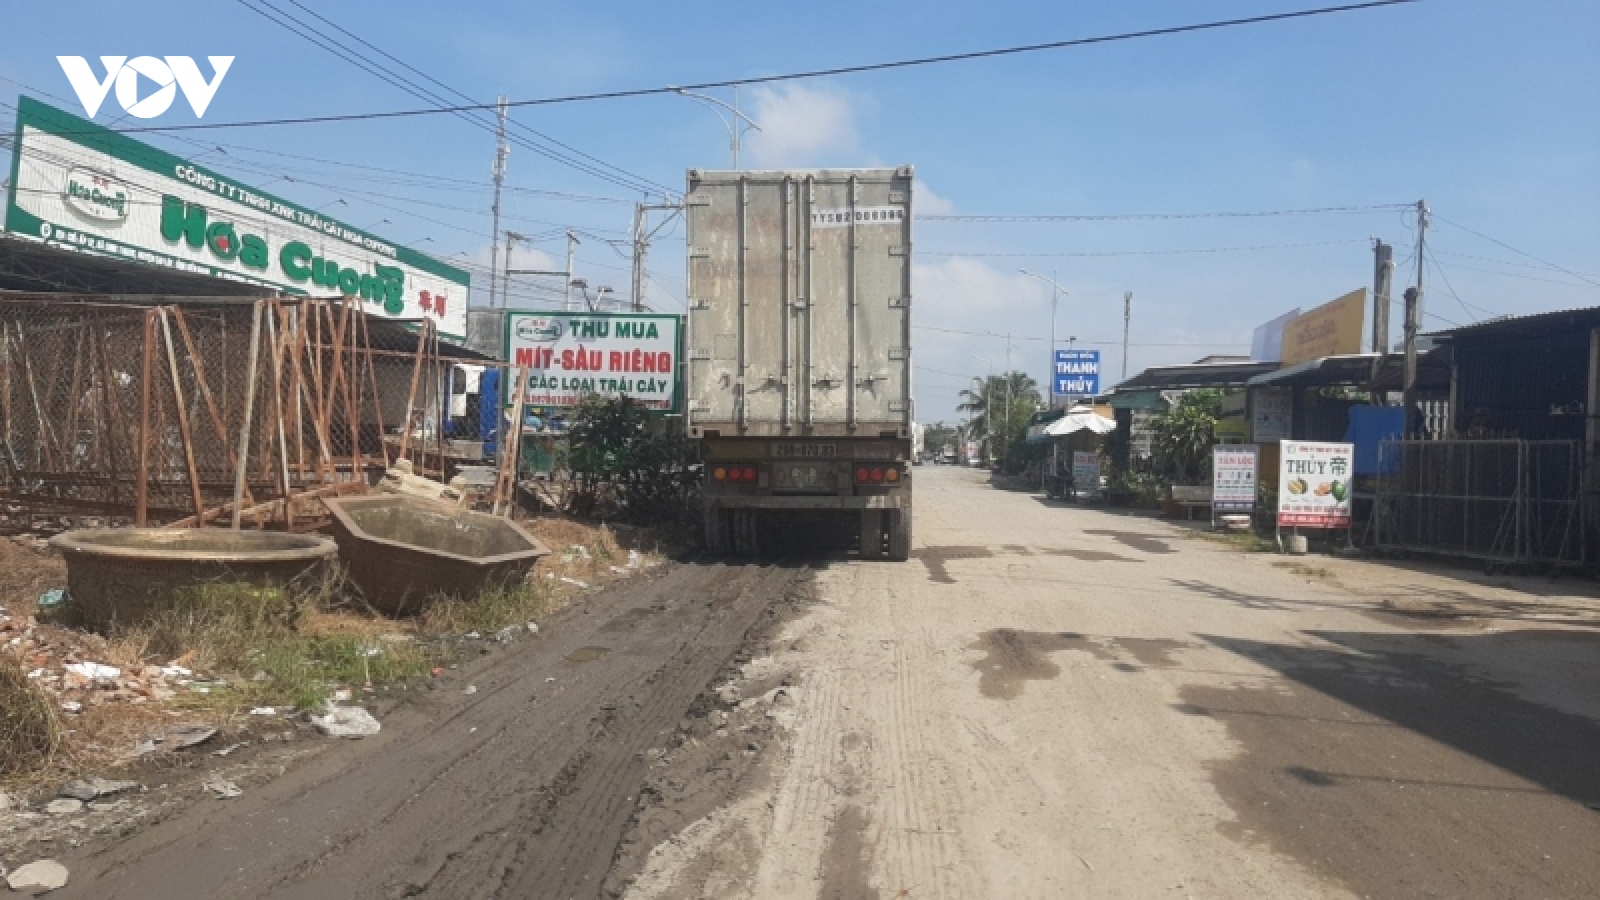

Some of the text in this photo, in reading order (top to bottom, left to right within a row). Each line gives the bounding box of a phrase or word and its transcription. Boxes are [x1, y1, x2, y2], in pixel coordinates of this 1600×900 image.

[176, 164, 215, 191] CÔNG
[218, 181, 236, 197] TY
[569, 319, 659, 338] THU MUA
[609, 348, 671, 373] RIÊNG
[1056, 362, 1098, 374] THANH
[529, 374, 558, 389] CÁC
[600, 376, 632, 392] TRÁI
[637, 376, 667, 392] CÂY
